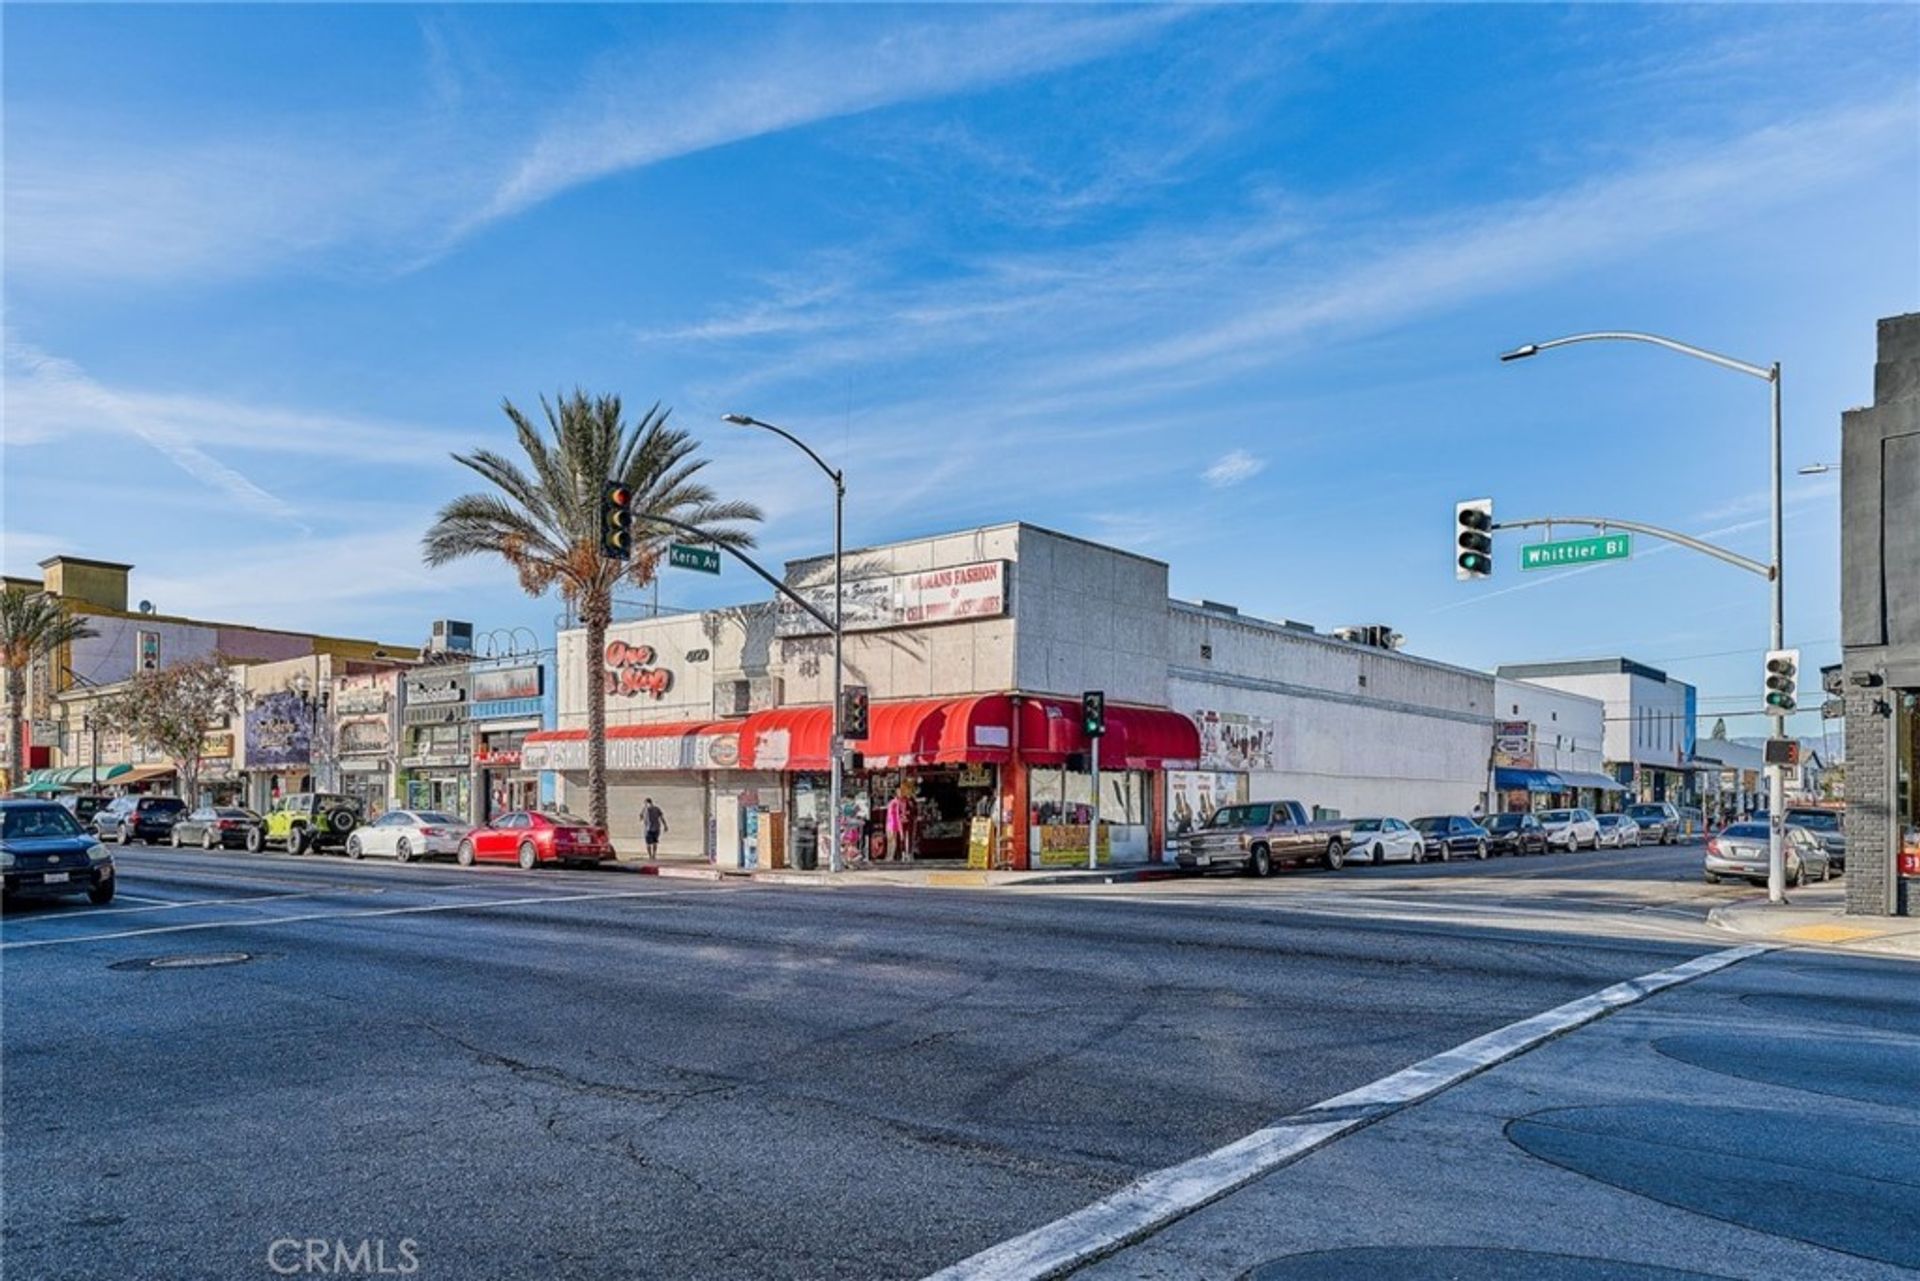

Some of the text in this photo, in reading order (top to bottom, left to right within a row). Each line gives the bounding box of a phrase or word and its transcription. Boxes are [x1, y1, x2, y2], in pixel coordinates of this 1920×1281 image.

[671, 548, 717, 569] Kern Av
[1528, 540, 1623, 563] Whittier Bl
[954, 564, 998, 585] FASHION
